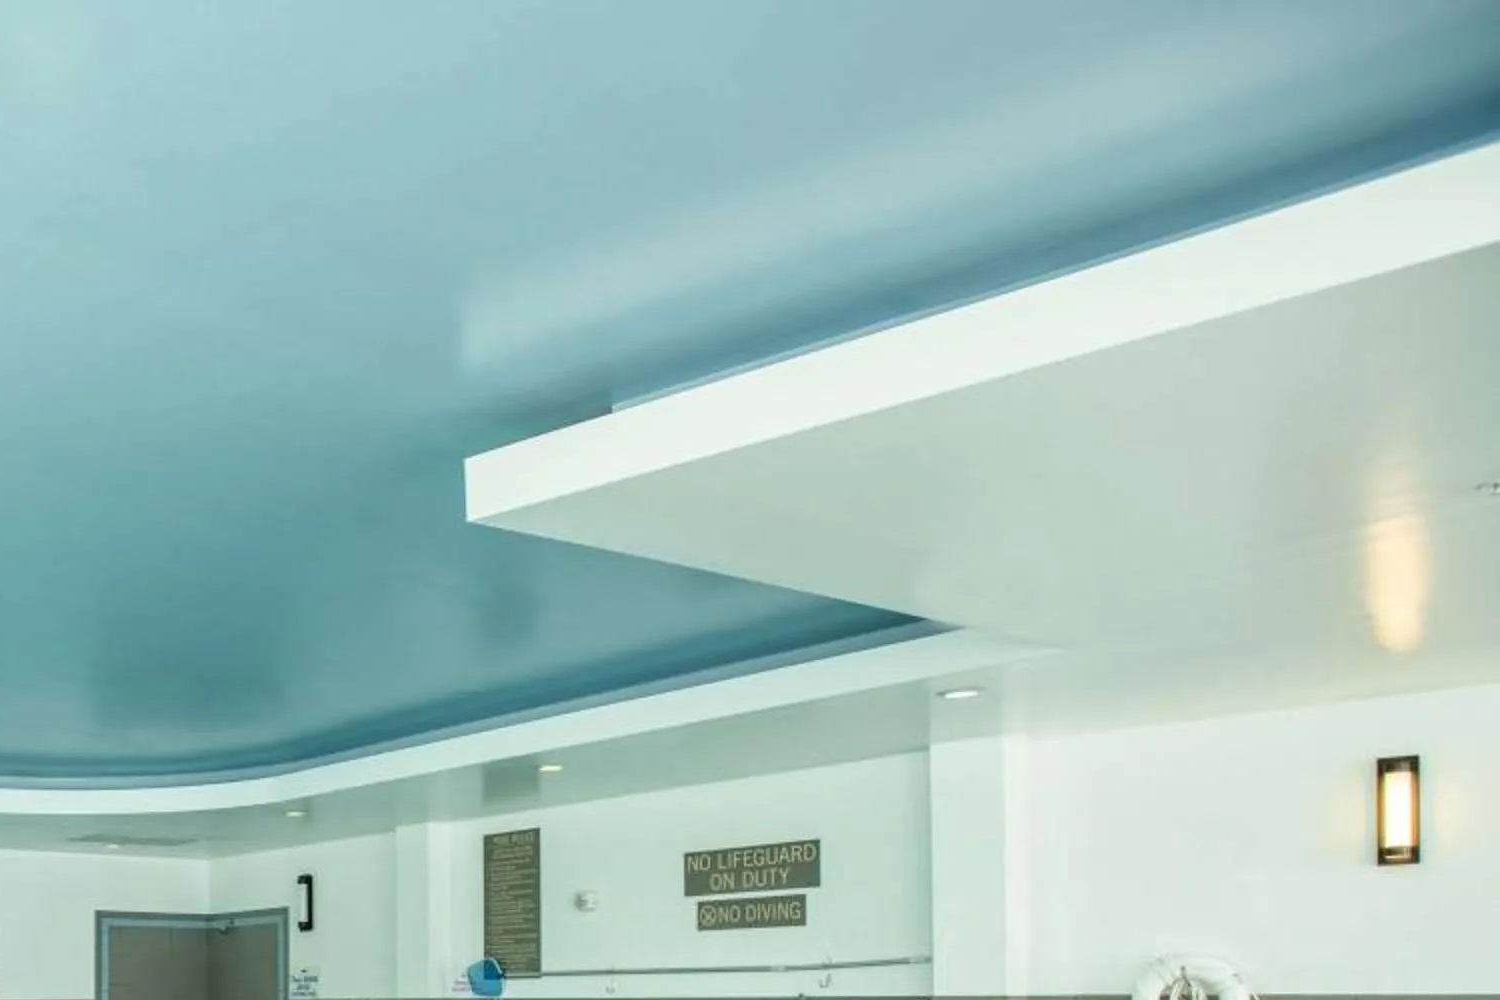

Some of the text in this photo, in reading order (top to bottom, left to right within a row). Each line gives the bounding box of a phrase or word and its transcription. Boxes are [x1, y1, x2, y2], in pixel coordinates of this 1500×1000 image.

[687, 843, 817, 875] NO LIFEGUARD
[710, 867, 789, 891] ON DUTY
[719, 901, 801, 923] NO DIVING
